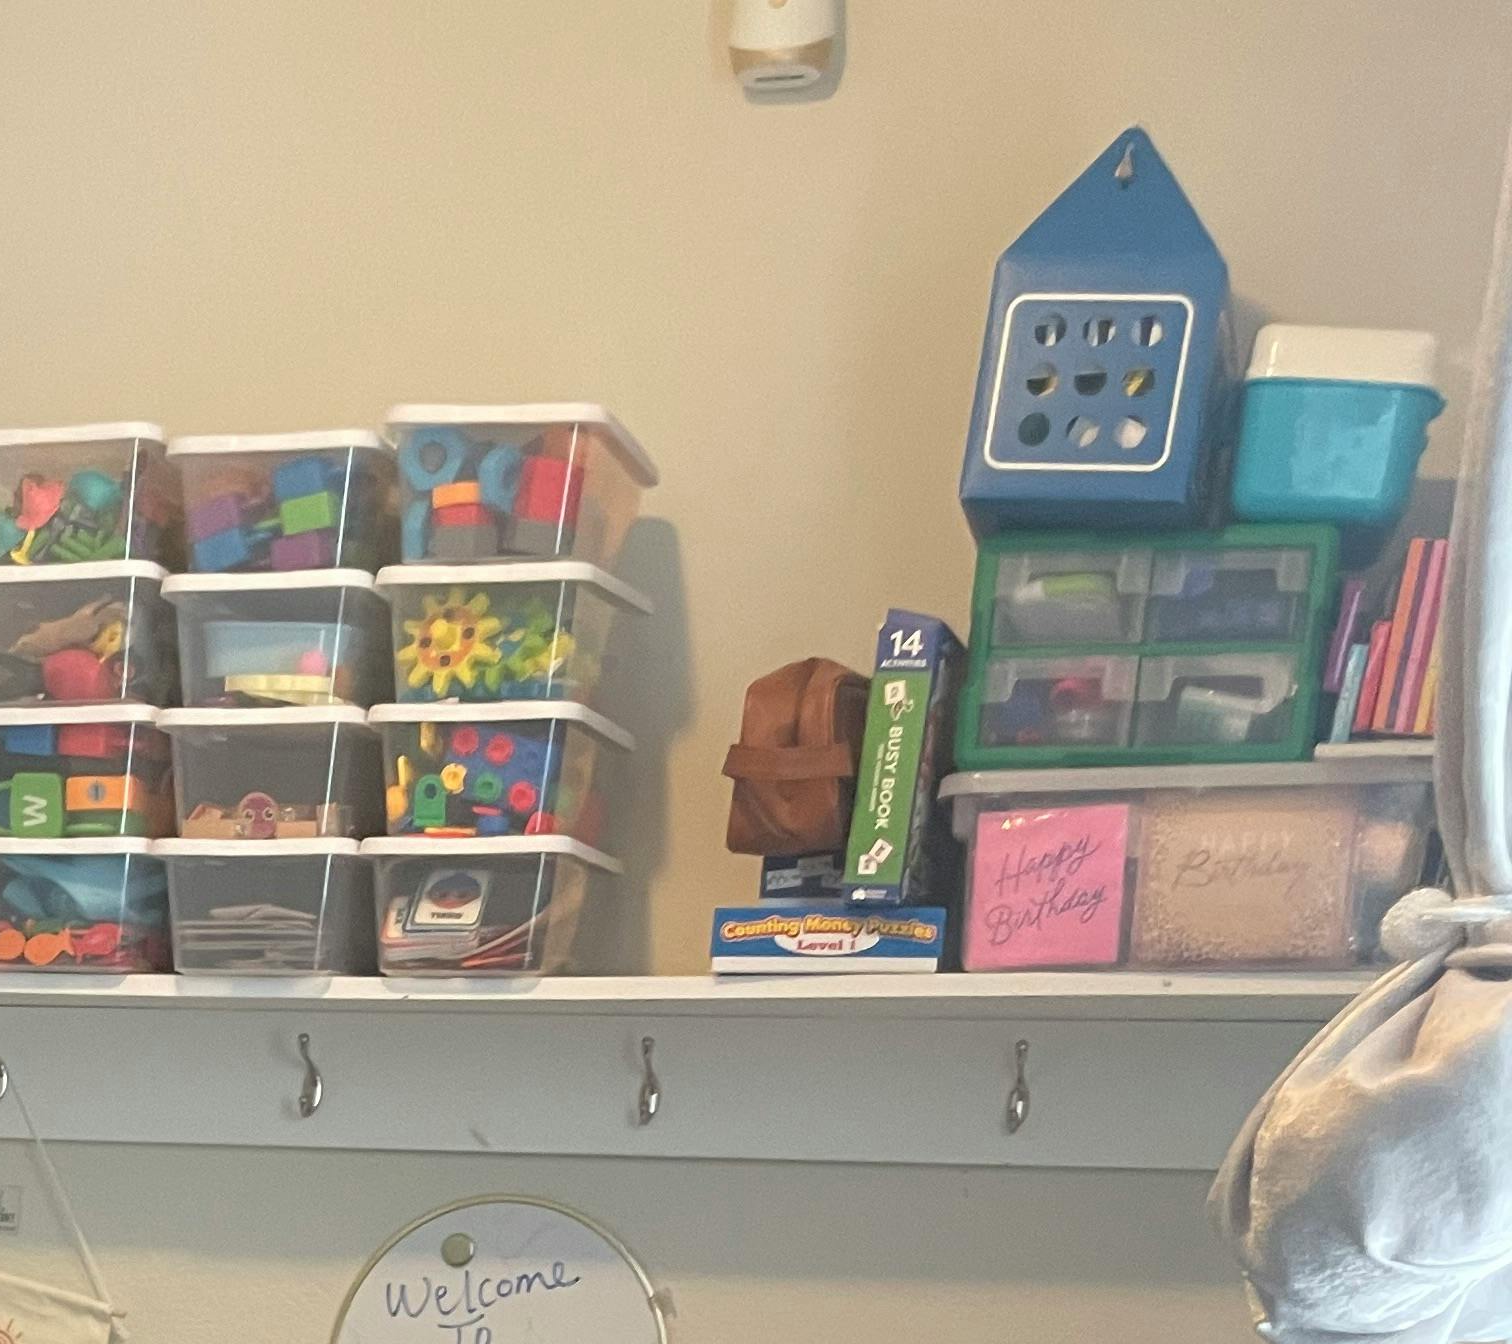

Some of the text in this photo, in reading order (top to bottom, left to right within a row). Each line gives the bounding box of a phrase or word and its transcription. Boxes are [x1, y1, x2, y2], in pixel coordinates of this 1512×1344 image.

[889, 629, 925, 657] 14
[885, 725, 904, 775] BUSY
[874, 777, 897, 830] BOOK
[995, 836, 1103, 897] Happy
[723, 916, 936, 942] Counting Money Puzzles
[986, 879, 1107, 946] Birthday
[796, 939, 844, 952] Level
[386, 1261, 581, 1319] Welcome
